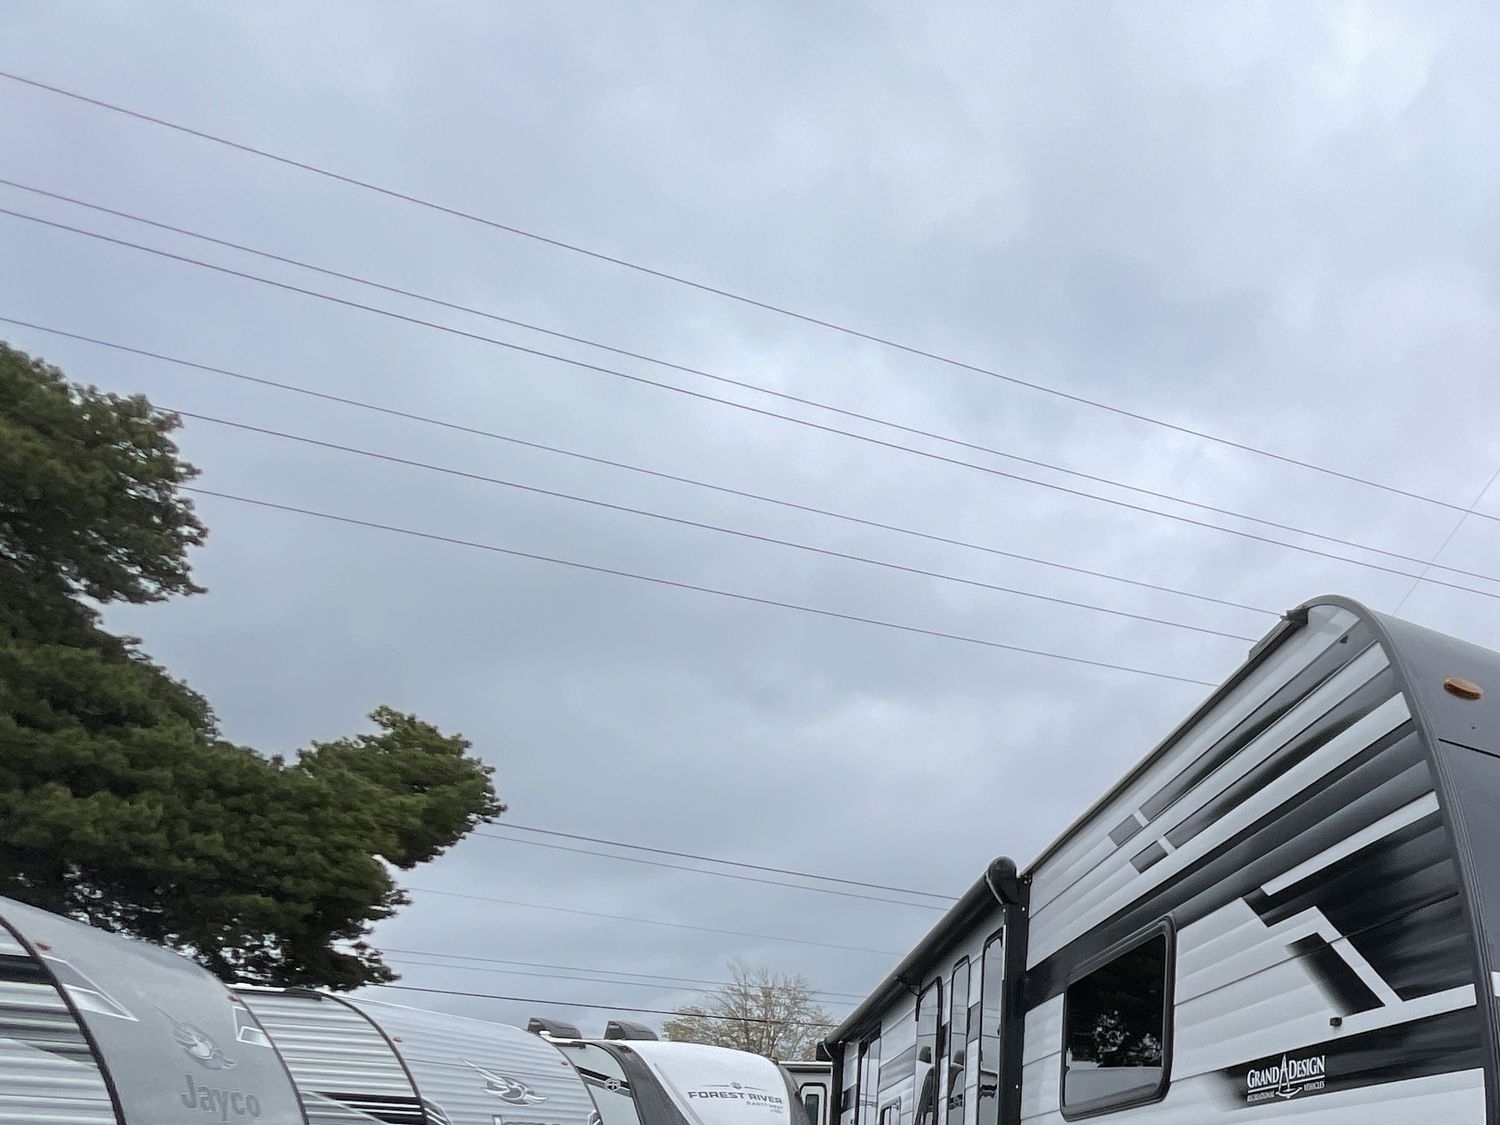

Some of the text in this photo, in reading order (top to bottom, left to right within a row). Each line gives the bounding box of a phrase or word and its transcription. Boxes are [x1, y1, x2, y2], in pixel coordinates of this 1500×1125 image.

[1247, 1055, 1326, 1089] GRAND DESIGN
[180, 1072, 262, 1122] Jayco
[687, 1091, 783, 1104] FOREST RIVER
